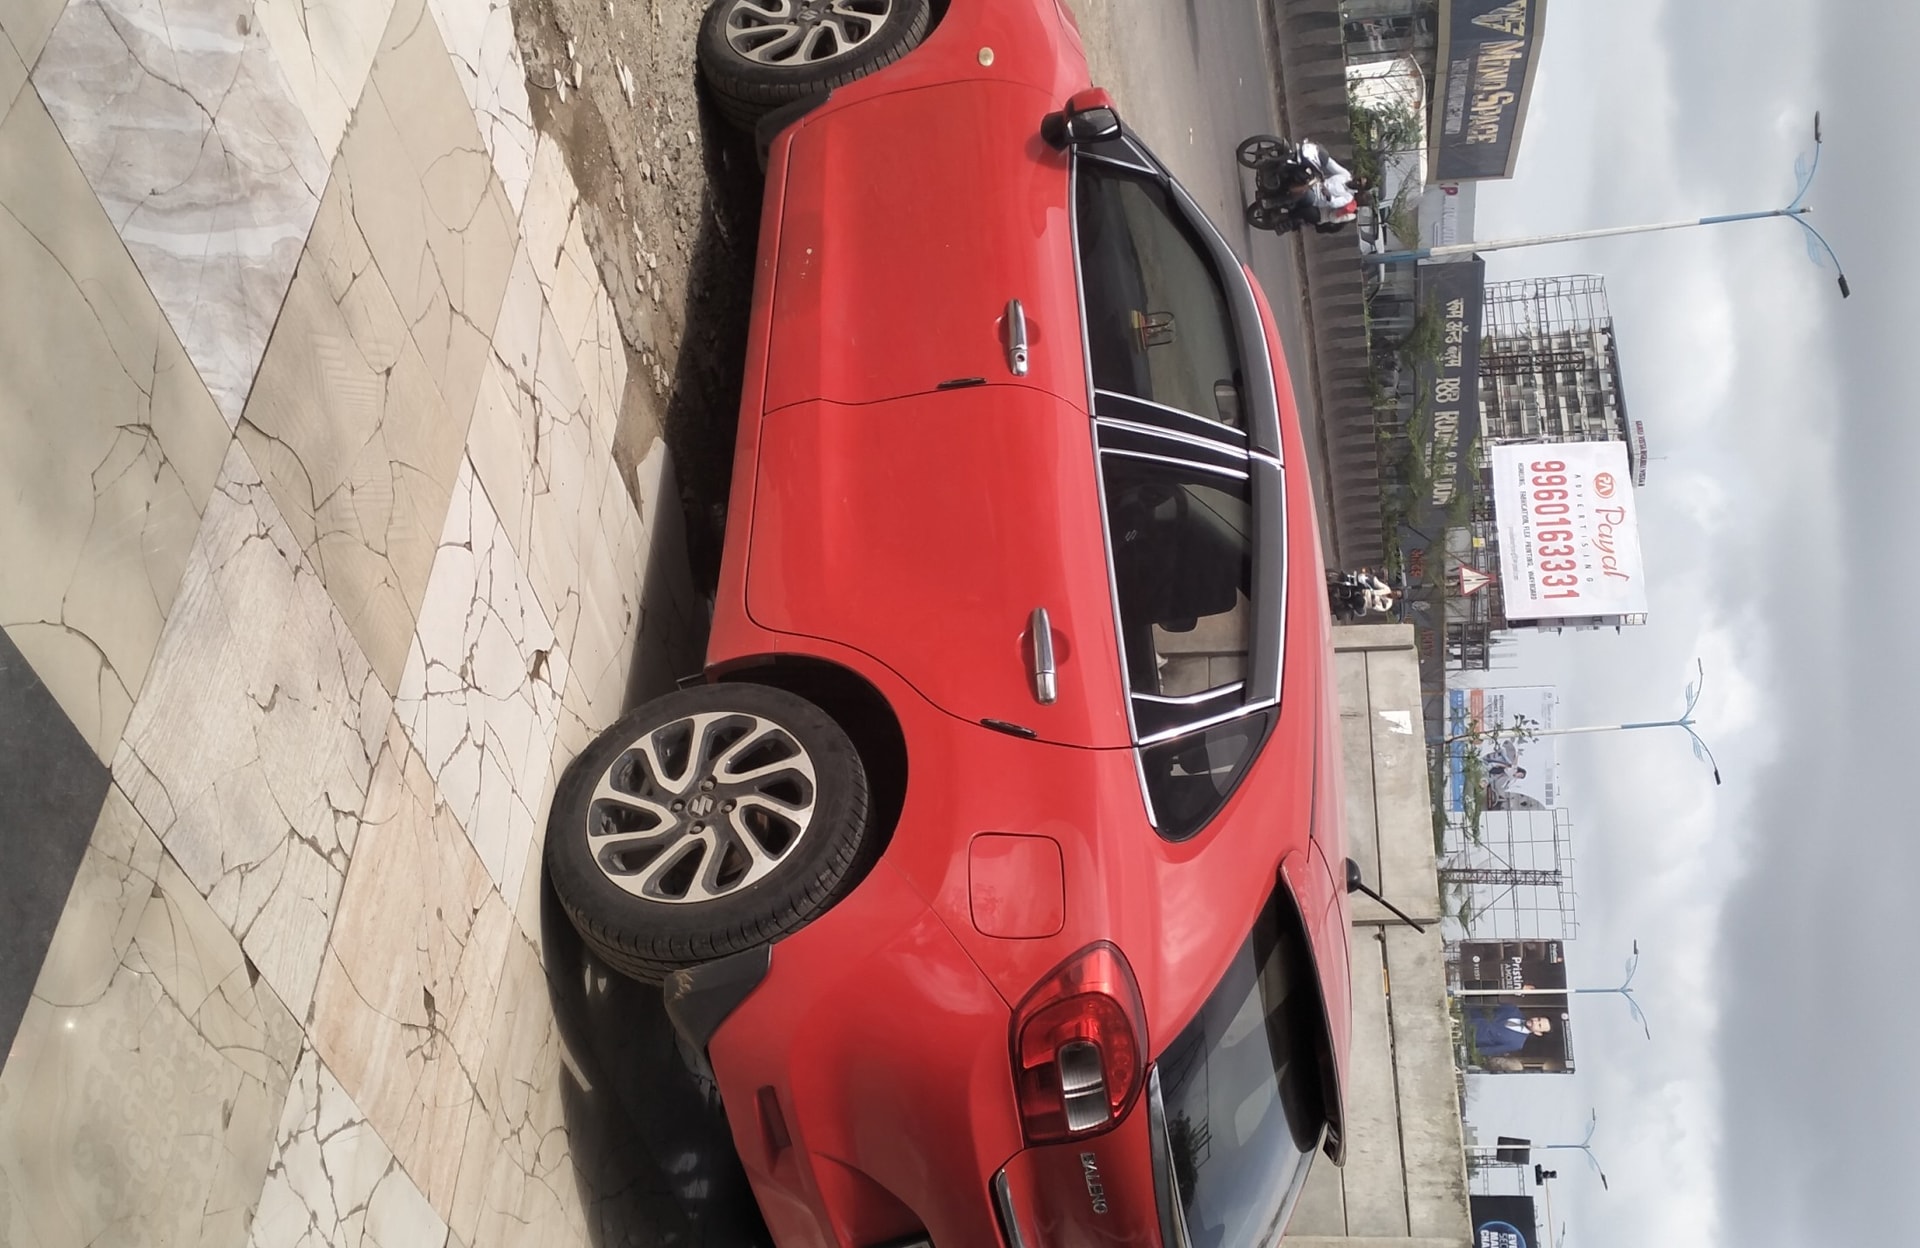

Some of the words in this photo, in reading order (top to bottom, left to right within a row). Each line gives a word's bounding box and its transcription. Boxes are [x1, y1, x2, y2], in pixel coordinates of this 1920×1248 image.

[1435, 376, 1461, 404] R&B
[1523, 526, 1531, 538] FLEX
[1530, 460, 1580, 599] 9960163331
[1574, 474, 1594, 583] ADVERTISING
[1592, 506, 1630, 581] Payal
[1080, 1152, 1108, 1215] BALENO
[1490, 1231, 1499, 1248] MA
